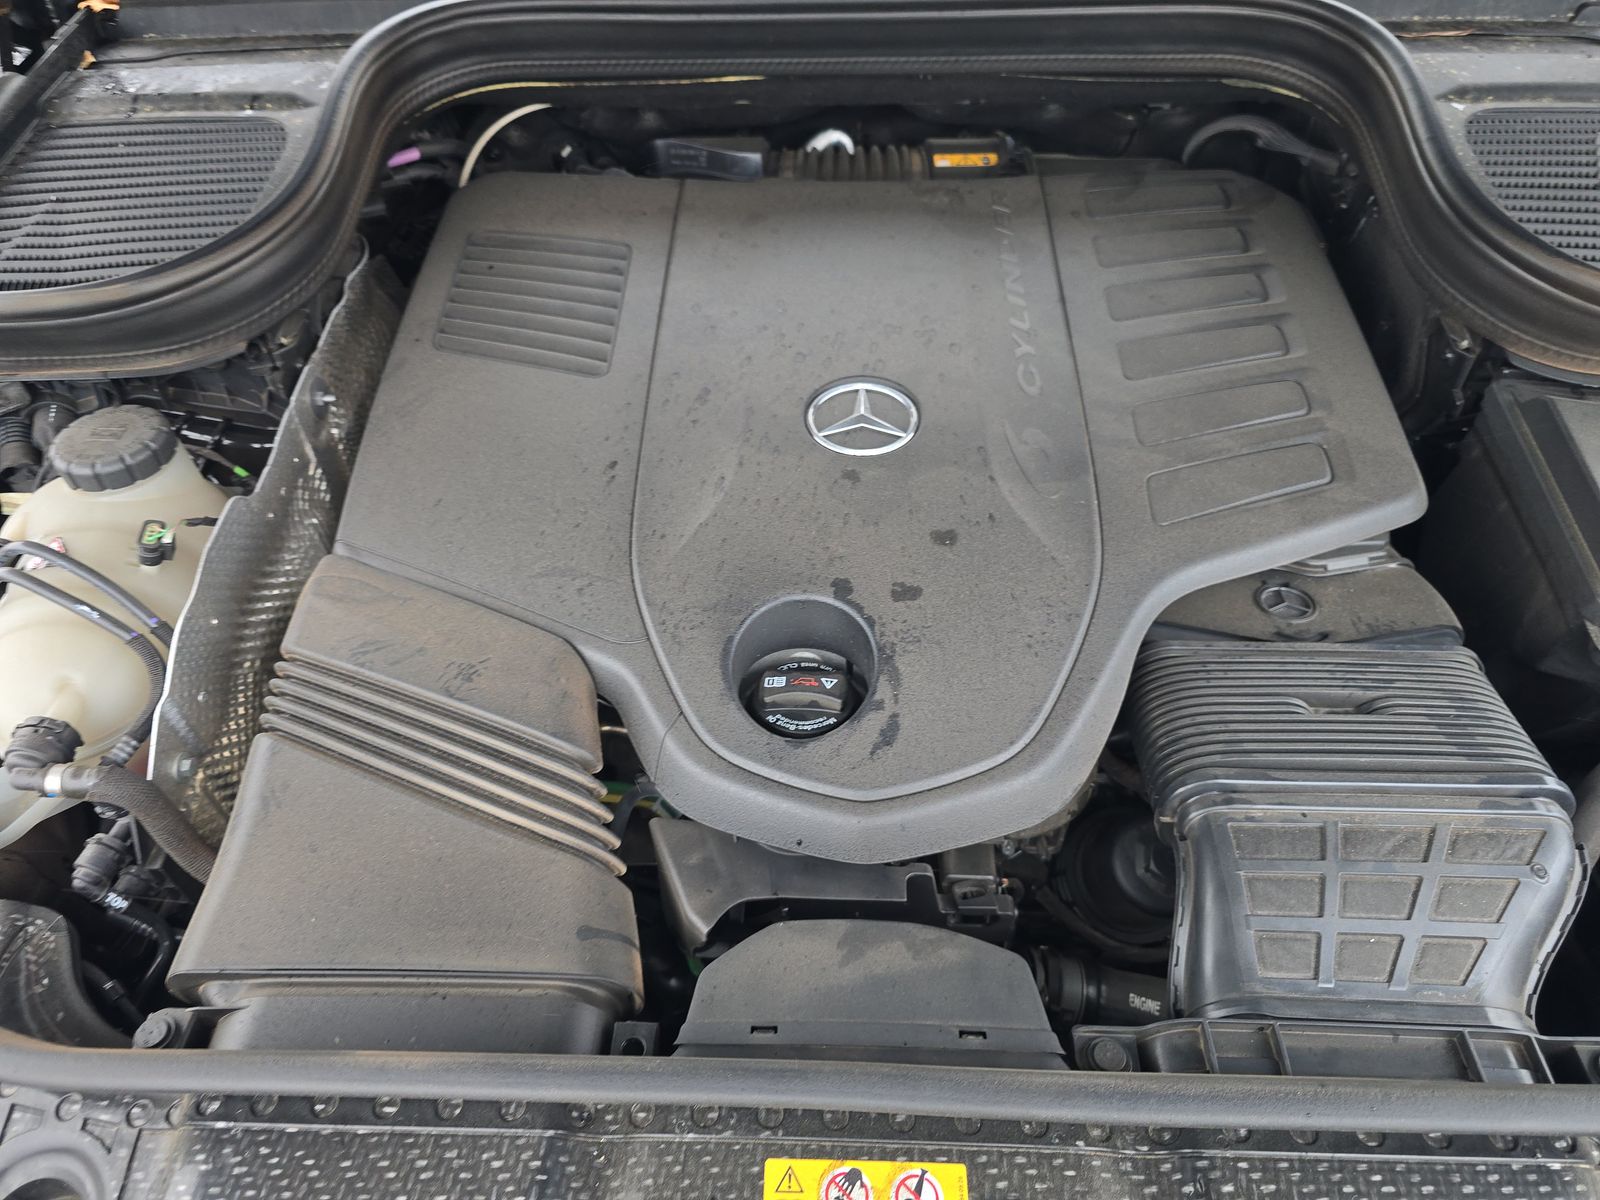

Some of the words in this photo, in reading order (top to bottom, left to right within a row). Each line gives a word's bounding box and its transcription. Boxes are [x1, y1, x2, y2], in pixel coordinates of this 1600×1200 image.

[774, 713, 827, 725] recommended
[776, 716, 837, 731] Mercedes-Benz
[104, 891, 129, 909] TOP
[1128, 992, 1162, 1016] ENGINE
